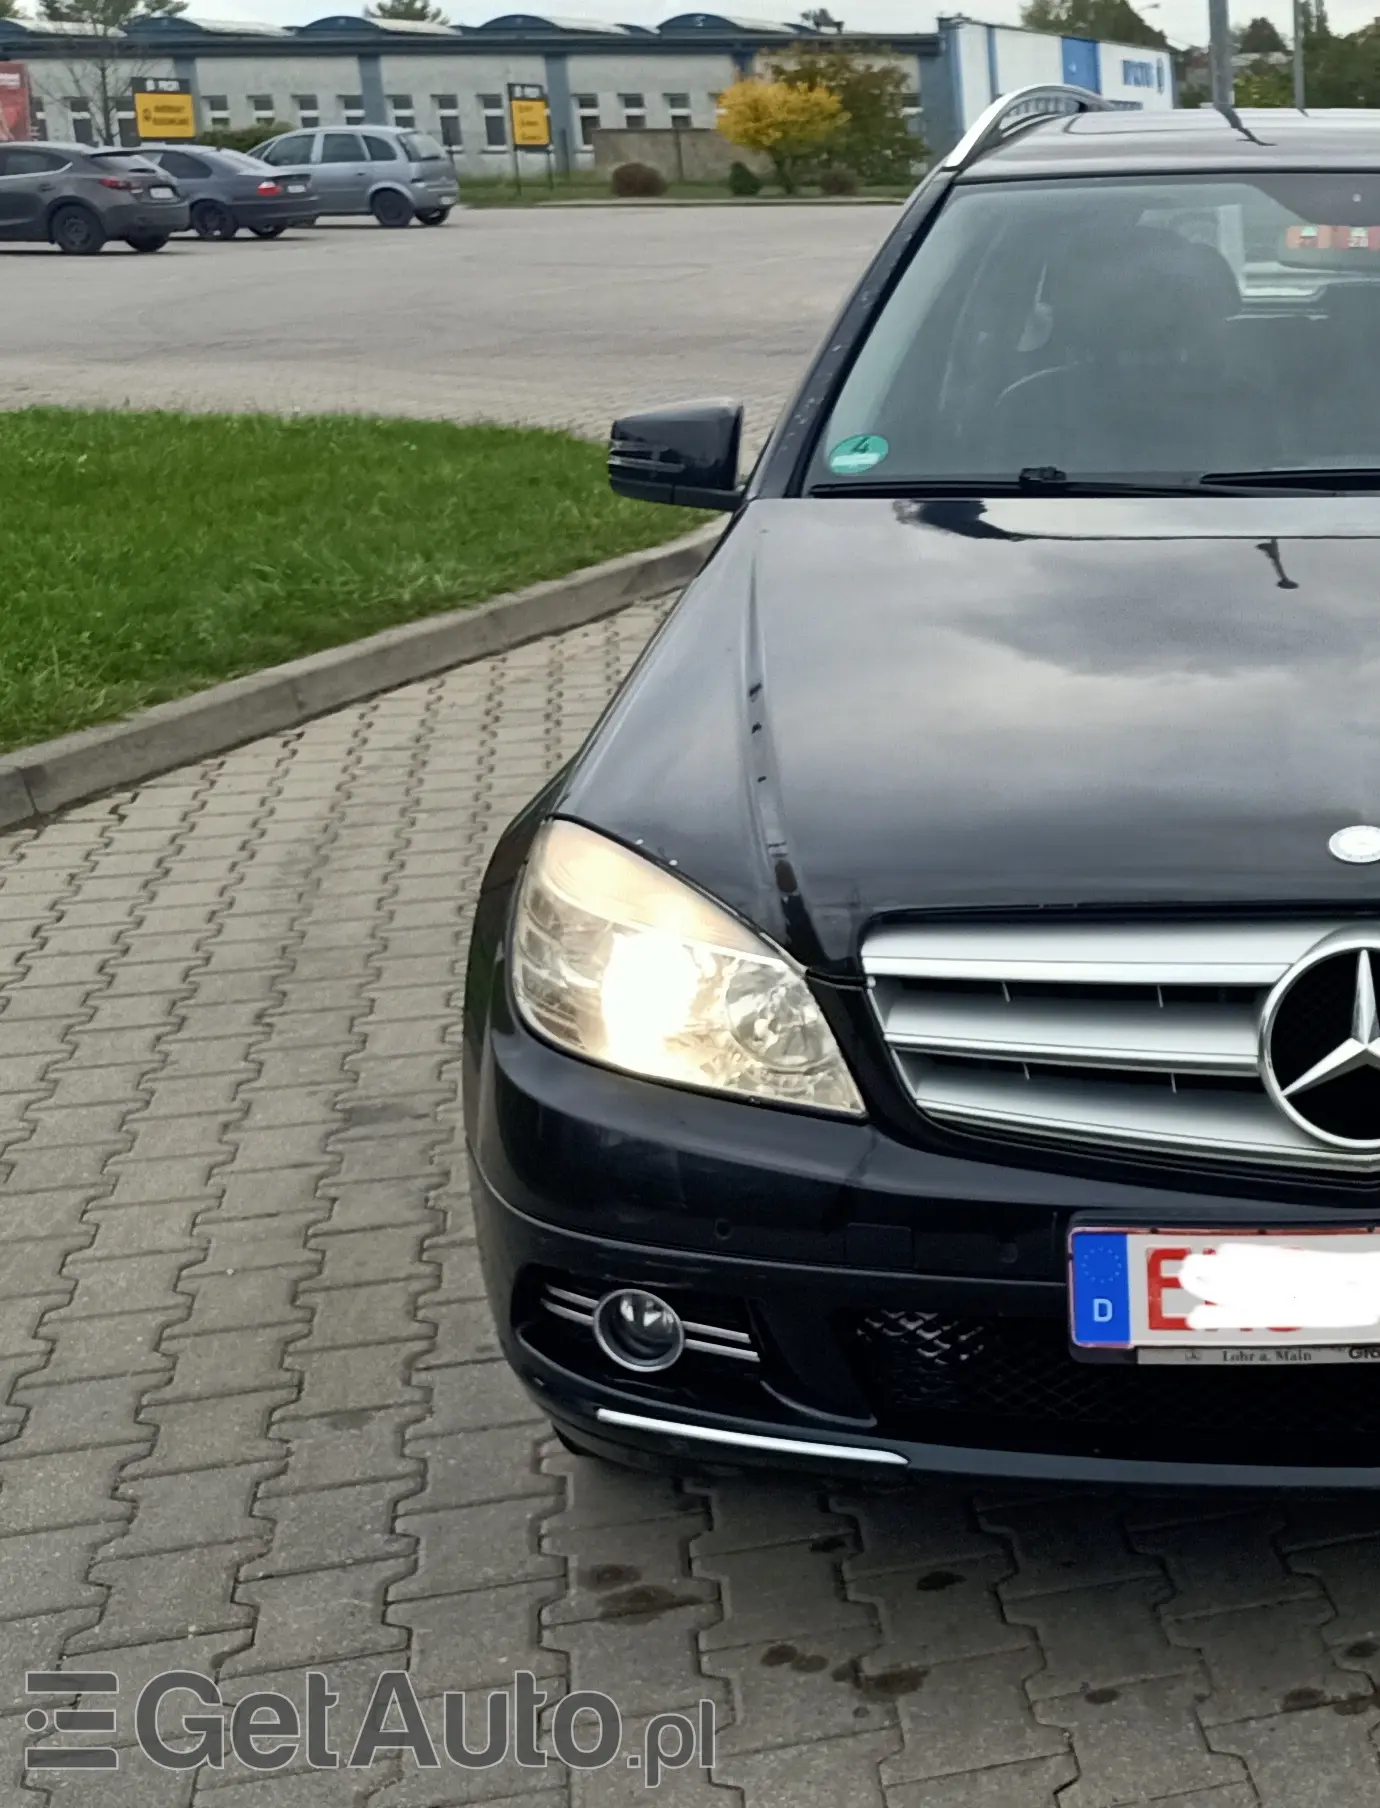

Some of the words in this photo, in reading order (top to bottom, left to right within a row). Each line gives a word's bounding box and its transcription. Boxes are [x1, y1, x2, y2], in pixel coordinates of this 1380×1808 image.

[850, 436, 870, 454] 4
[1093, 1298, 1113, 1323] D
[1275, 1350, 1313, 1362] Main
